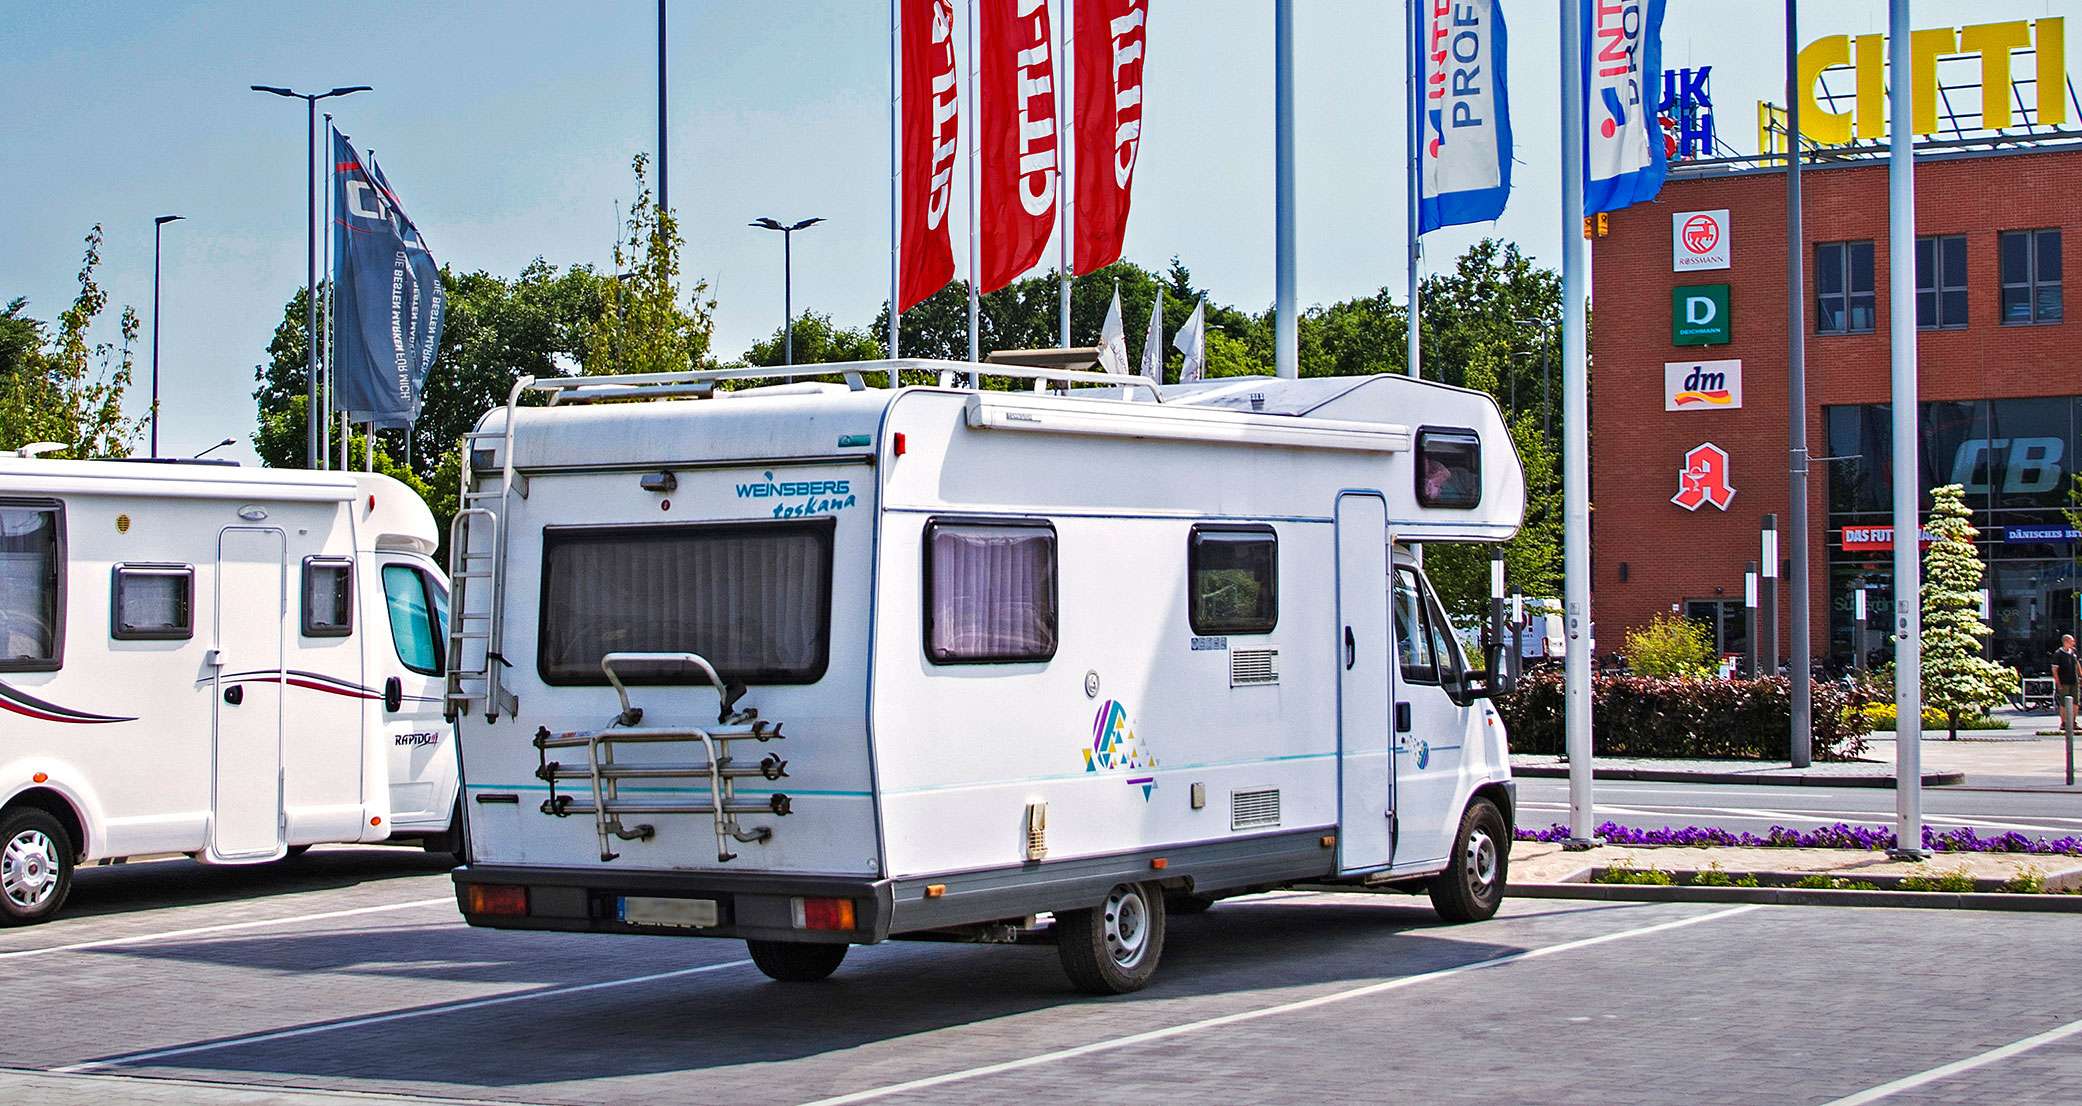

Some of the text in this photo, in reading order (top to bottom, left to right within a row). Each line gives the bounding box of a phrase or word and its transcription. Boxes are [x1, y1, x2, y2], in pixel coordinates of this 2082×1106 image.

[1452, 3, 1483, 128] PROF
[1797, 16, 2067, 146] CITTI
[1685, 296, 1717, 325] D
[1679, 327, 1721, 336] DEICHMANN
[1684, 366, 1725, 391] dm
[1949, 436, 2066, 495] CB
[736, 478, 850, 498] WEINSBERG
[773, 494, 856, 519] toskana
[1846, 529, 1869, 543] DAS
[2009, 529, 2062, 539] DÄNISCHES
